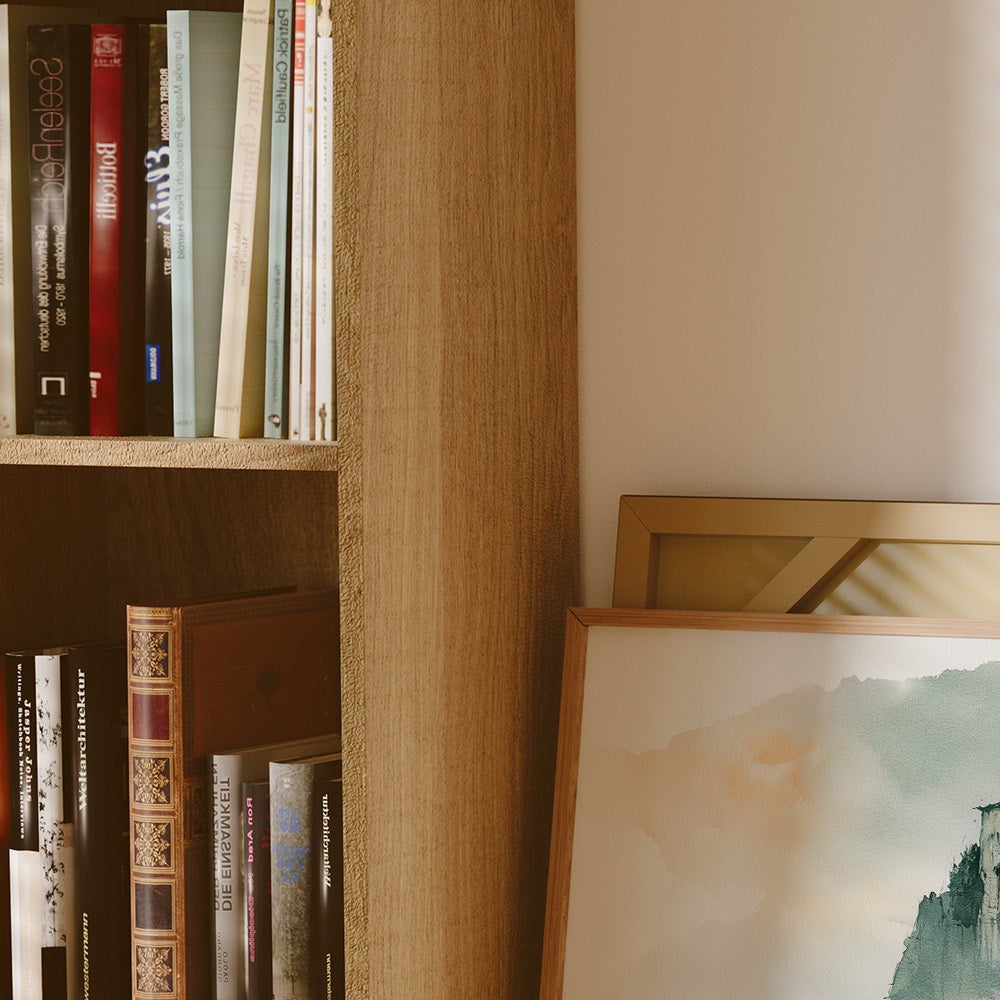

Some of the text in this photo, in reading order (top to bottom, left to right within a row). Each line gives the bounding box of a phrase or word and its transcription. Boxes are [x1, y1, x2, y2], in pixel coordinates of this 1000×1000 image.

[23, 698, 33, 803] Jasper Johns
[77, 668, 87, 812] Weltarchitektur
